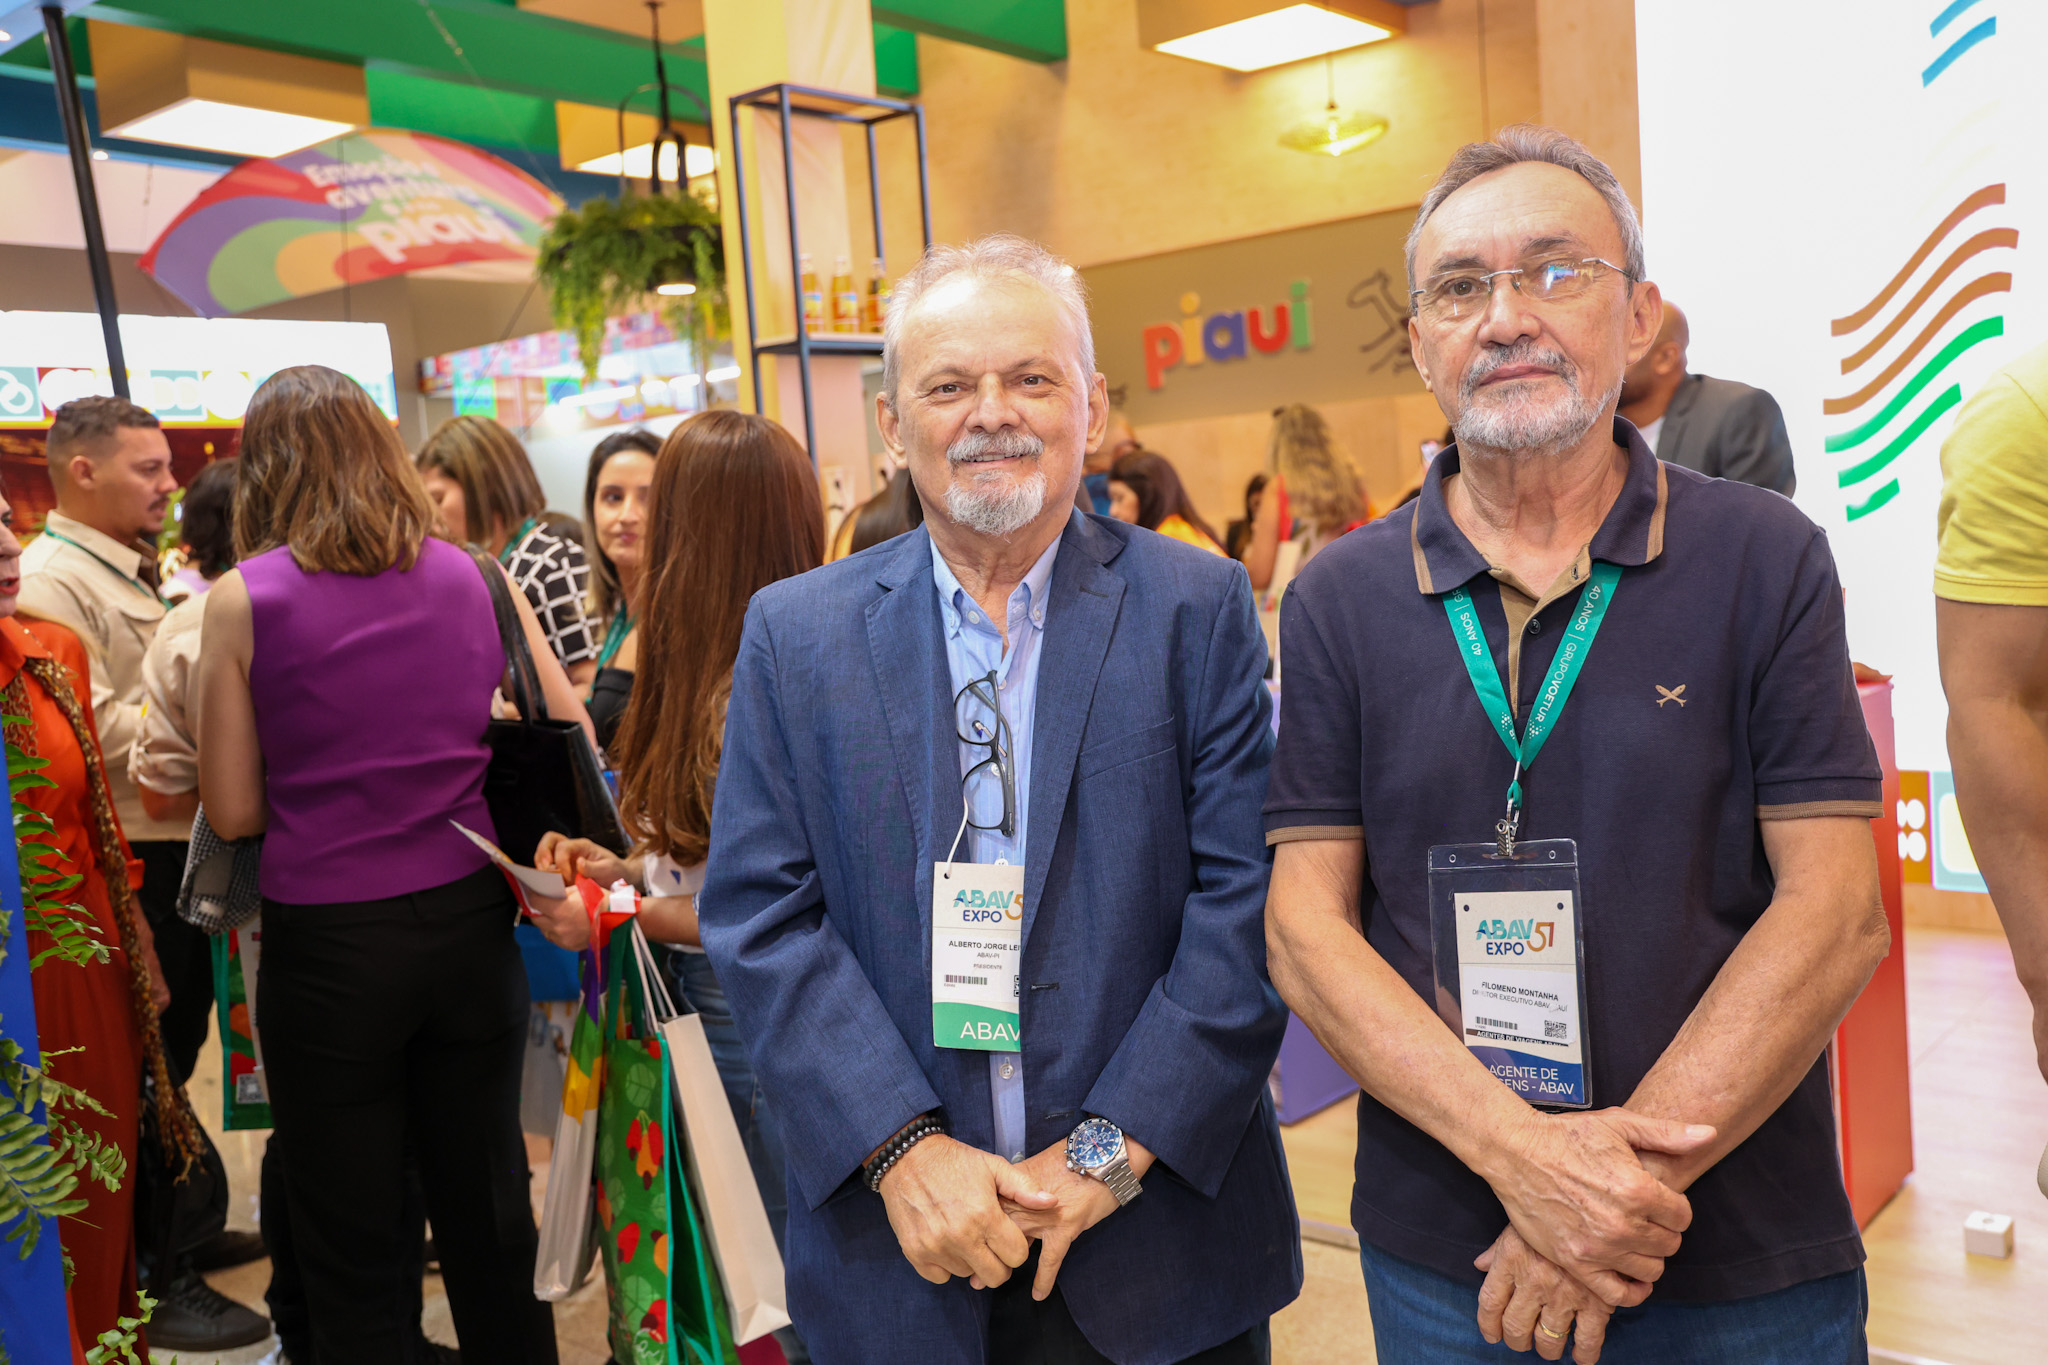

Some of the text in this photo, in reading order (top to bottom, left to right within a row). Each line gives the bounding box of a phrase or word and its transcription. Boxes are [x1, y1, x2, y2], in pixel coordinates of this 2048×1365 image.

[1588, 585, 1601, 600] 40
[1575, 600, 1595, 632] ANOS
[1460, 612, 1478, 641] ANOS
[1471, 642, 1482, 656] 40
[963, 909, 1002, 923] EXPO
[948, 940, 982, 949] ALBERTO
[983, 942, 1007, 951] JORGE
[1486, 942, 1525, 956] EXPO
[1472, 989, 1498, 999] DITOR
[1499, 994, 1533, 1006] EXECUTIVO
[1481, 981, 1559, 1001] FILOMENO MONTANHA
[960, 1021, 1020, 1042] ABAV
[1489, 1064, 1559, 1081] AGENTE DE
[1538, 1081, 1574, 1095] ABAV
